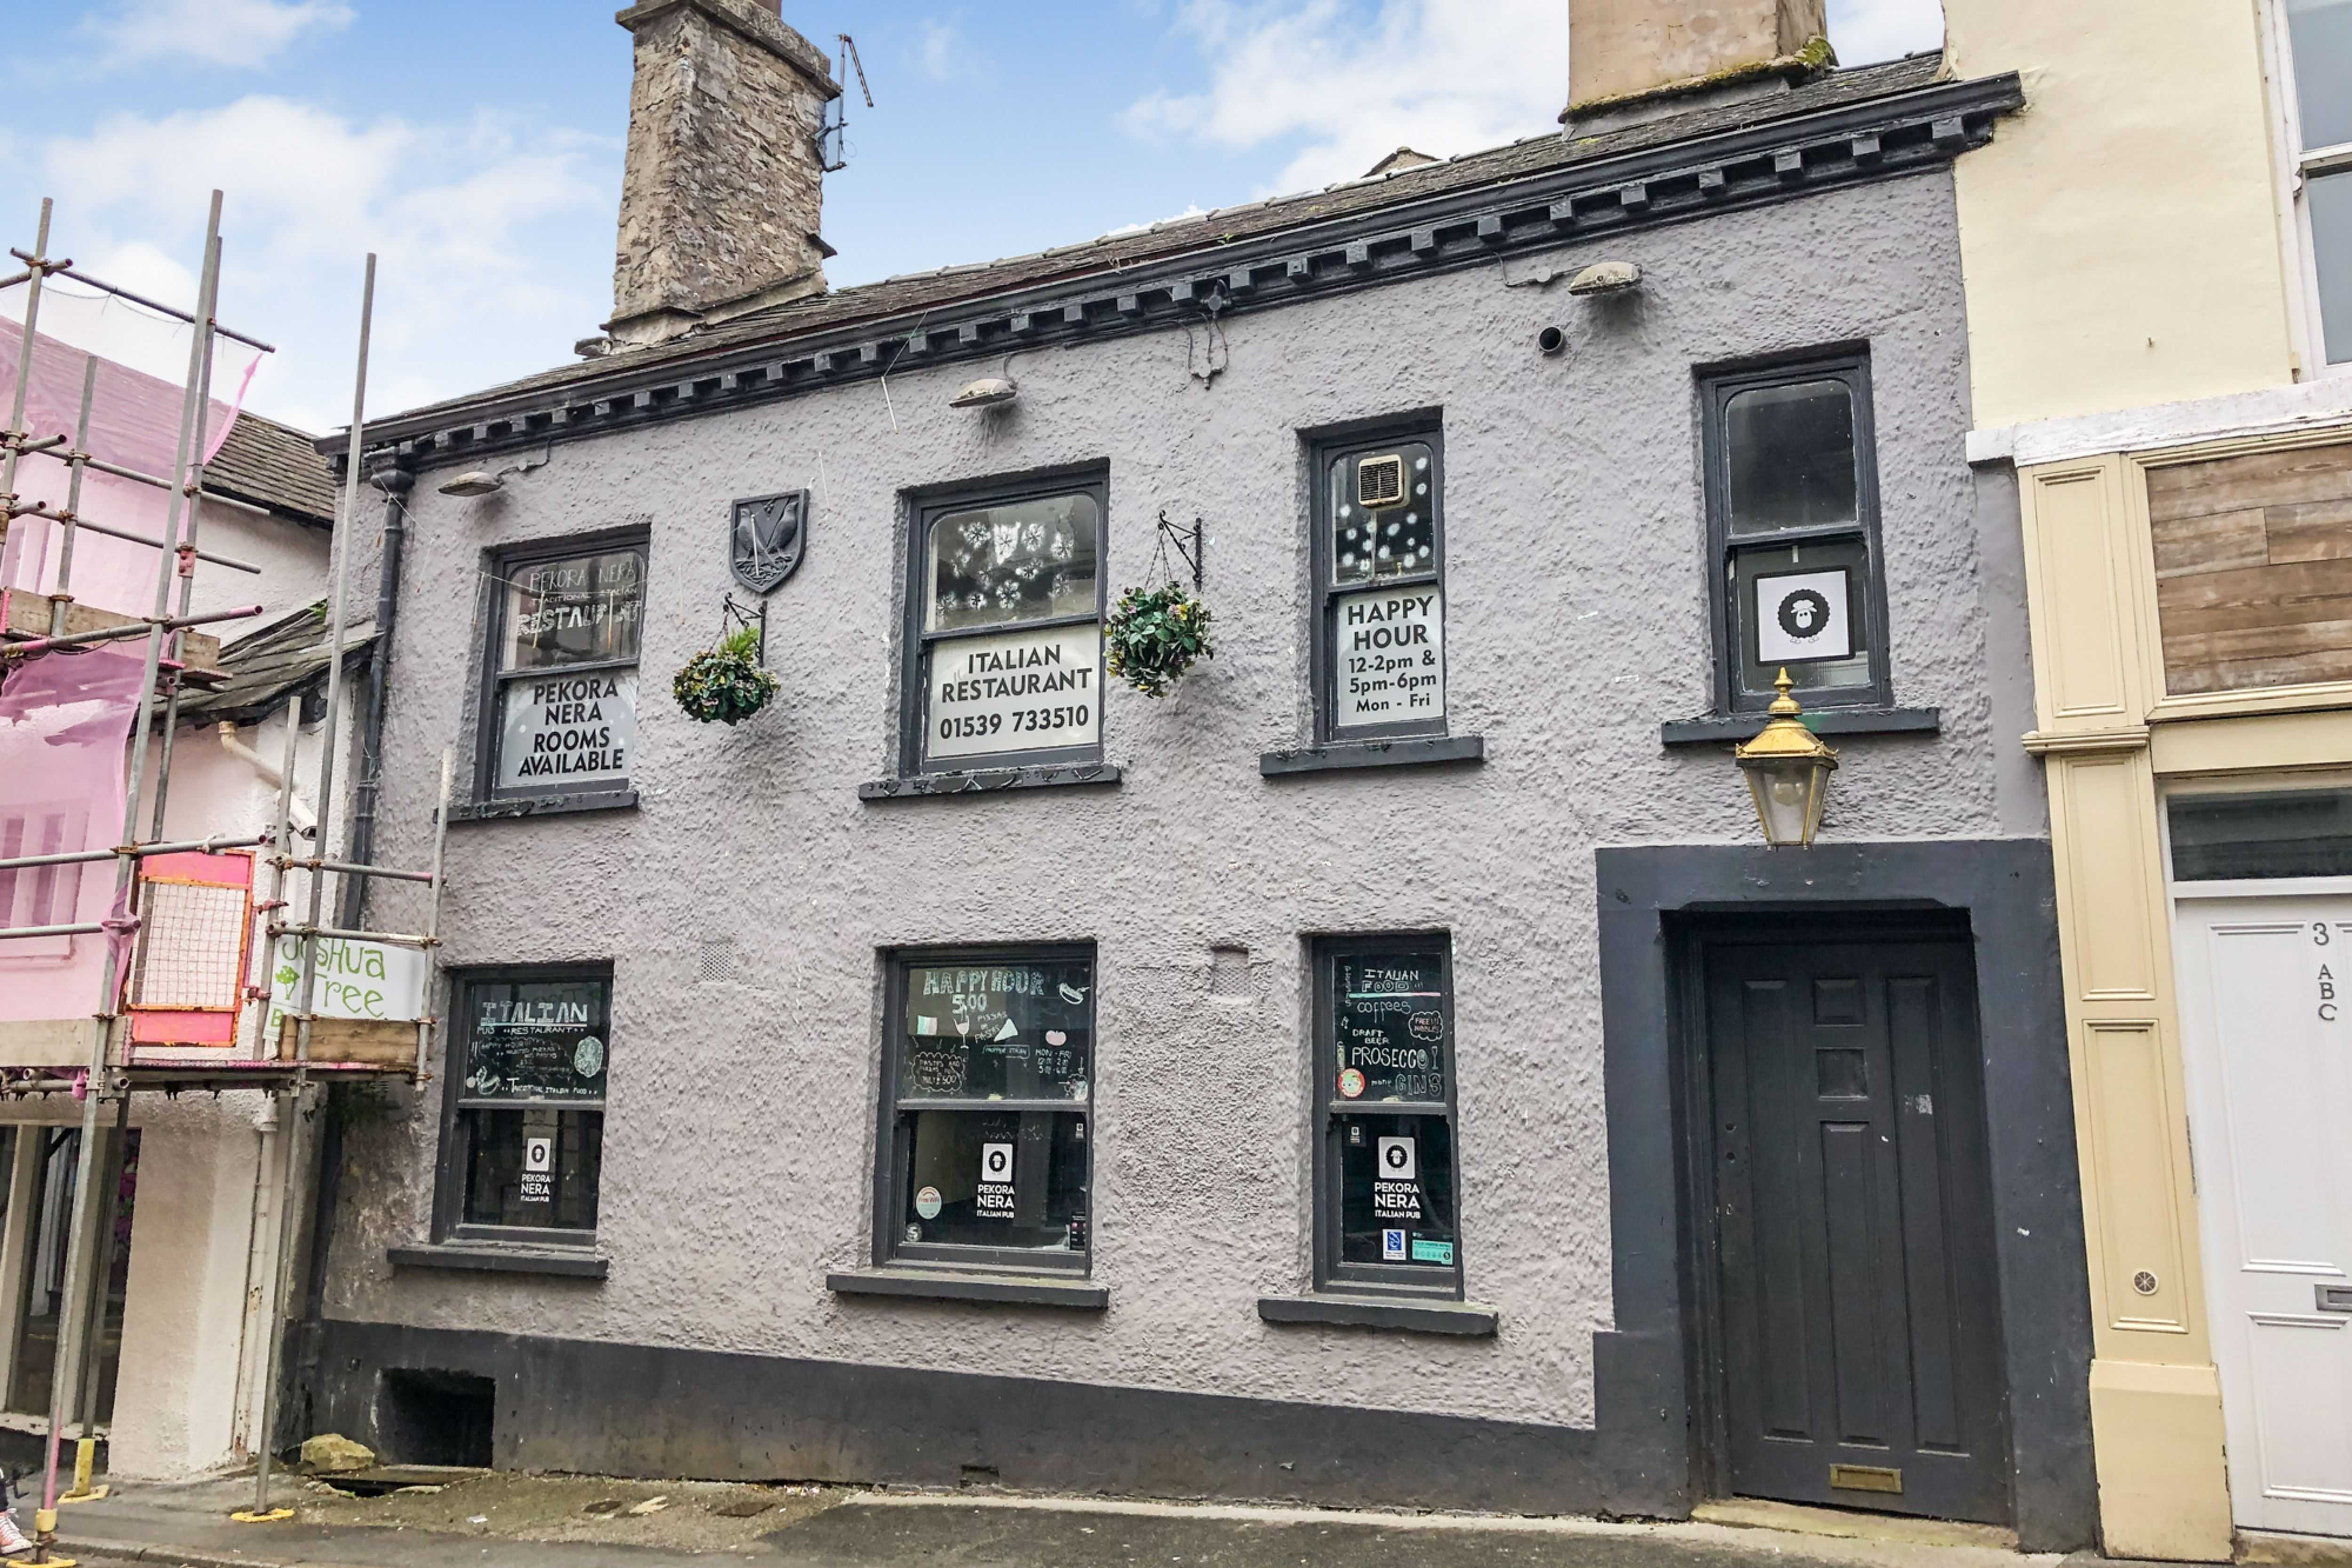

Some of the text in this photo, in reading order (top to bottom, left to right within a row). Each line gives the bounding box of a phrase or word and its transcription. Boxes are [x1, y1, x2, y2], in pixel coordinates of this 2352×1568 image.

[1348, 596, 1434, 625] HAPPY
[1354, 624, 1428, 651] HOUR
[968, 645, 1060, 674] ITALIAN
[1349, 650, 1436, 674] 12-2pm &
[534, 677, 619, 705] PEKORA
[942, 668, 1092, 703] RESTAURANT
[1350, 673, 1436, 696] 5pm-6pm
[545, 701, 603, 725] NERA
[1356, 699, 1389, 712] Mon
[1410, 693, 1430, 707] Fri
[940, 705, 1089, 739] 01539 733510
[533, 727, 610, 753] ROOMS
[517, 748, 624, 777] AVAILABLE
[2313, 923, 2329, 946] 3
[923, 970, 1044, 995] HAPPY HOUR
[1365, 969, 1419, 980] ITALIAN
[481, 1001, 588, 1025] ITALIAN
[1352, 1046, 1429, 1070] PROSECCO
[521, 1174, 551, 1183] PEKORA
[521, 1183, 550, 1194] NERA
[978, 1184, 1015, 1194] PEKORA
[1375, 1182, 1420, 1194] PEKORA
[977, 1194, 1015, 1209] NERA
[1375, 1194, 1421, 1209] NERA
[1375, 1210, 1405, 1218] ITALIAN
